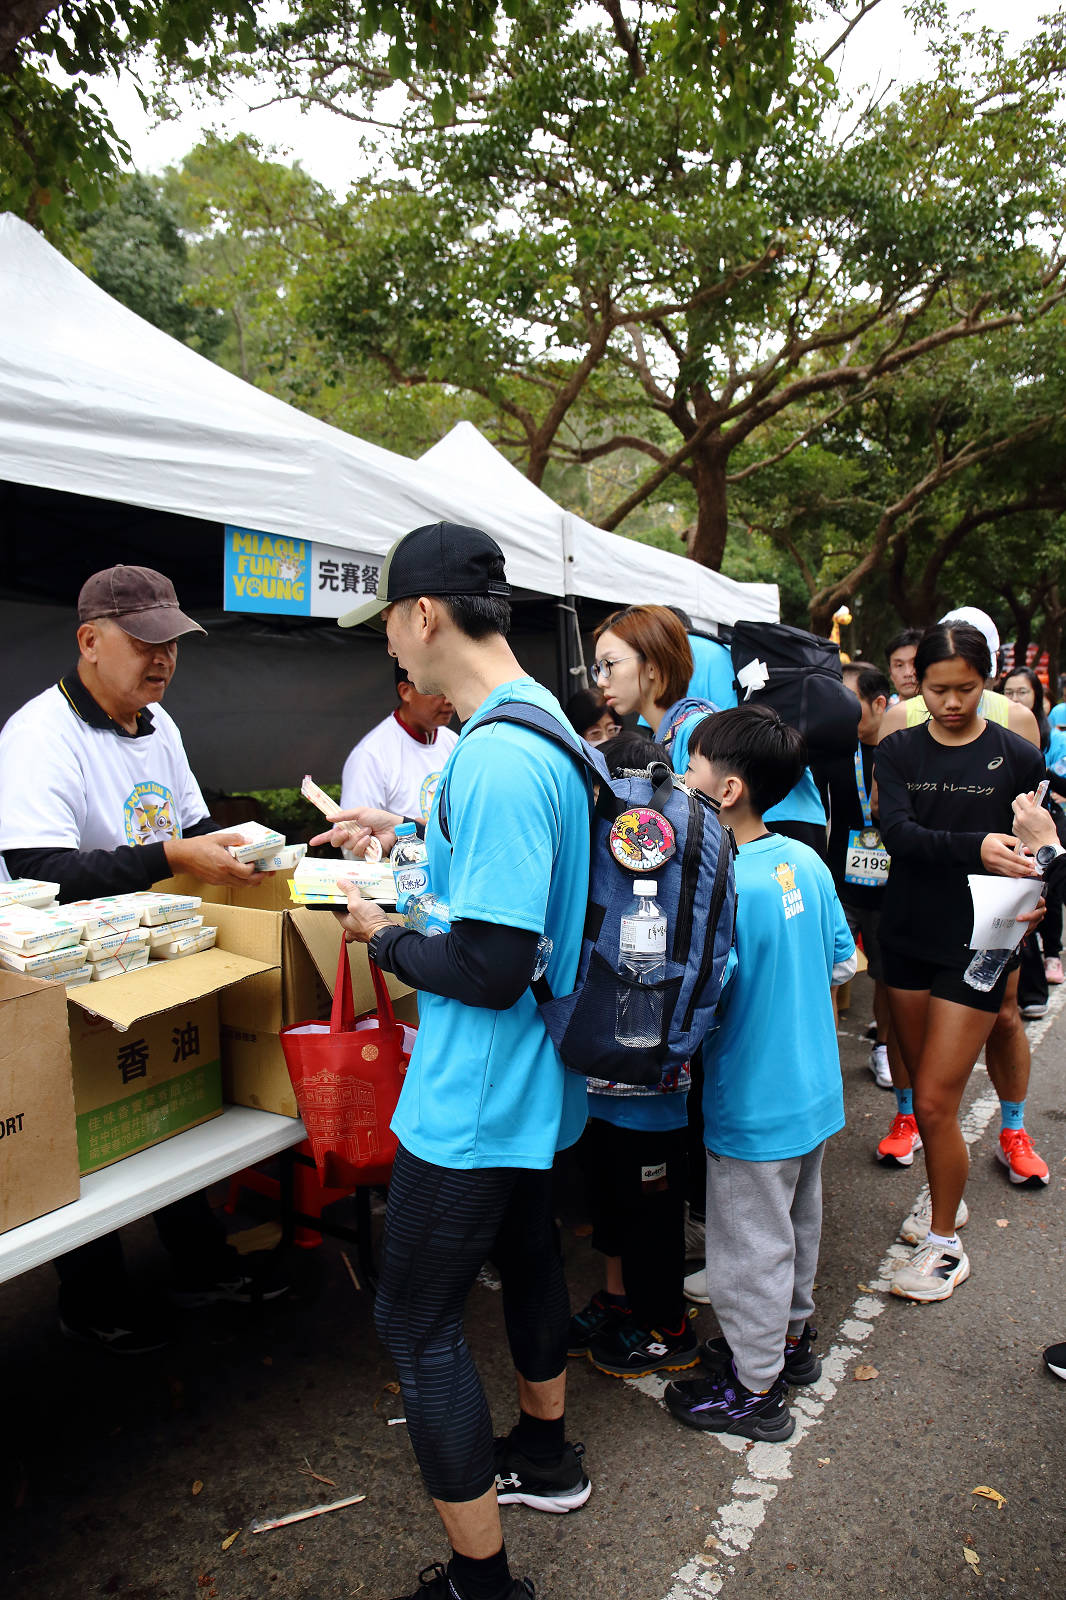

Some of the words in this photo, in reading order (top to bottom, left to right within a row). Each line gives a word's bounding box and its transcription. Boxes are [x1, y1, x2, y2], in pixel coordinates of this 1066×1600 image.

[232, 532, 306, 560] MIAOLI
[238, 555, 280, 578] FUN
[232, 575, 305, 601] YOUNG
[851, 856, 888, 871] 2199
